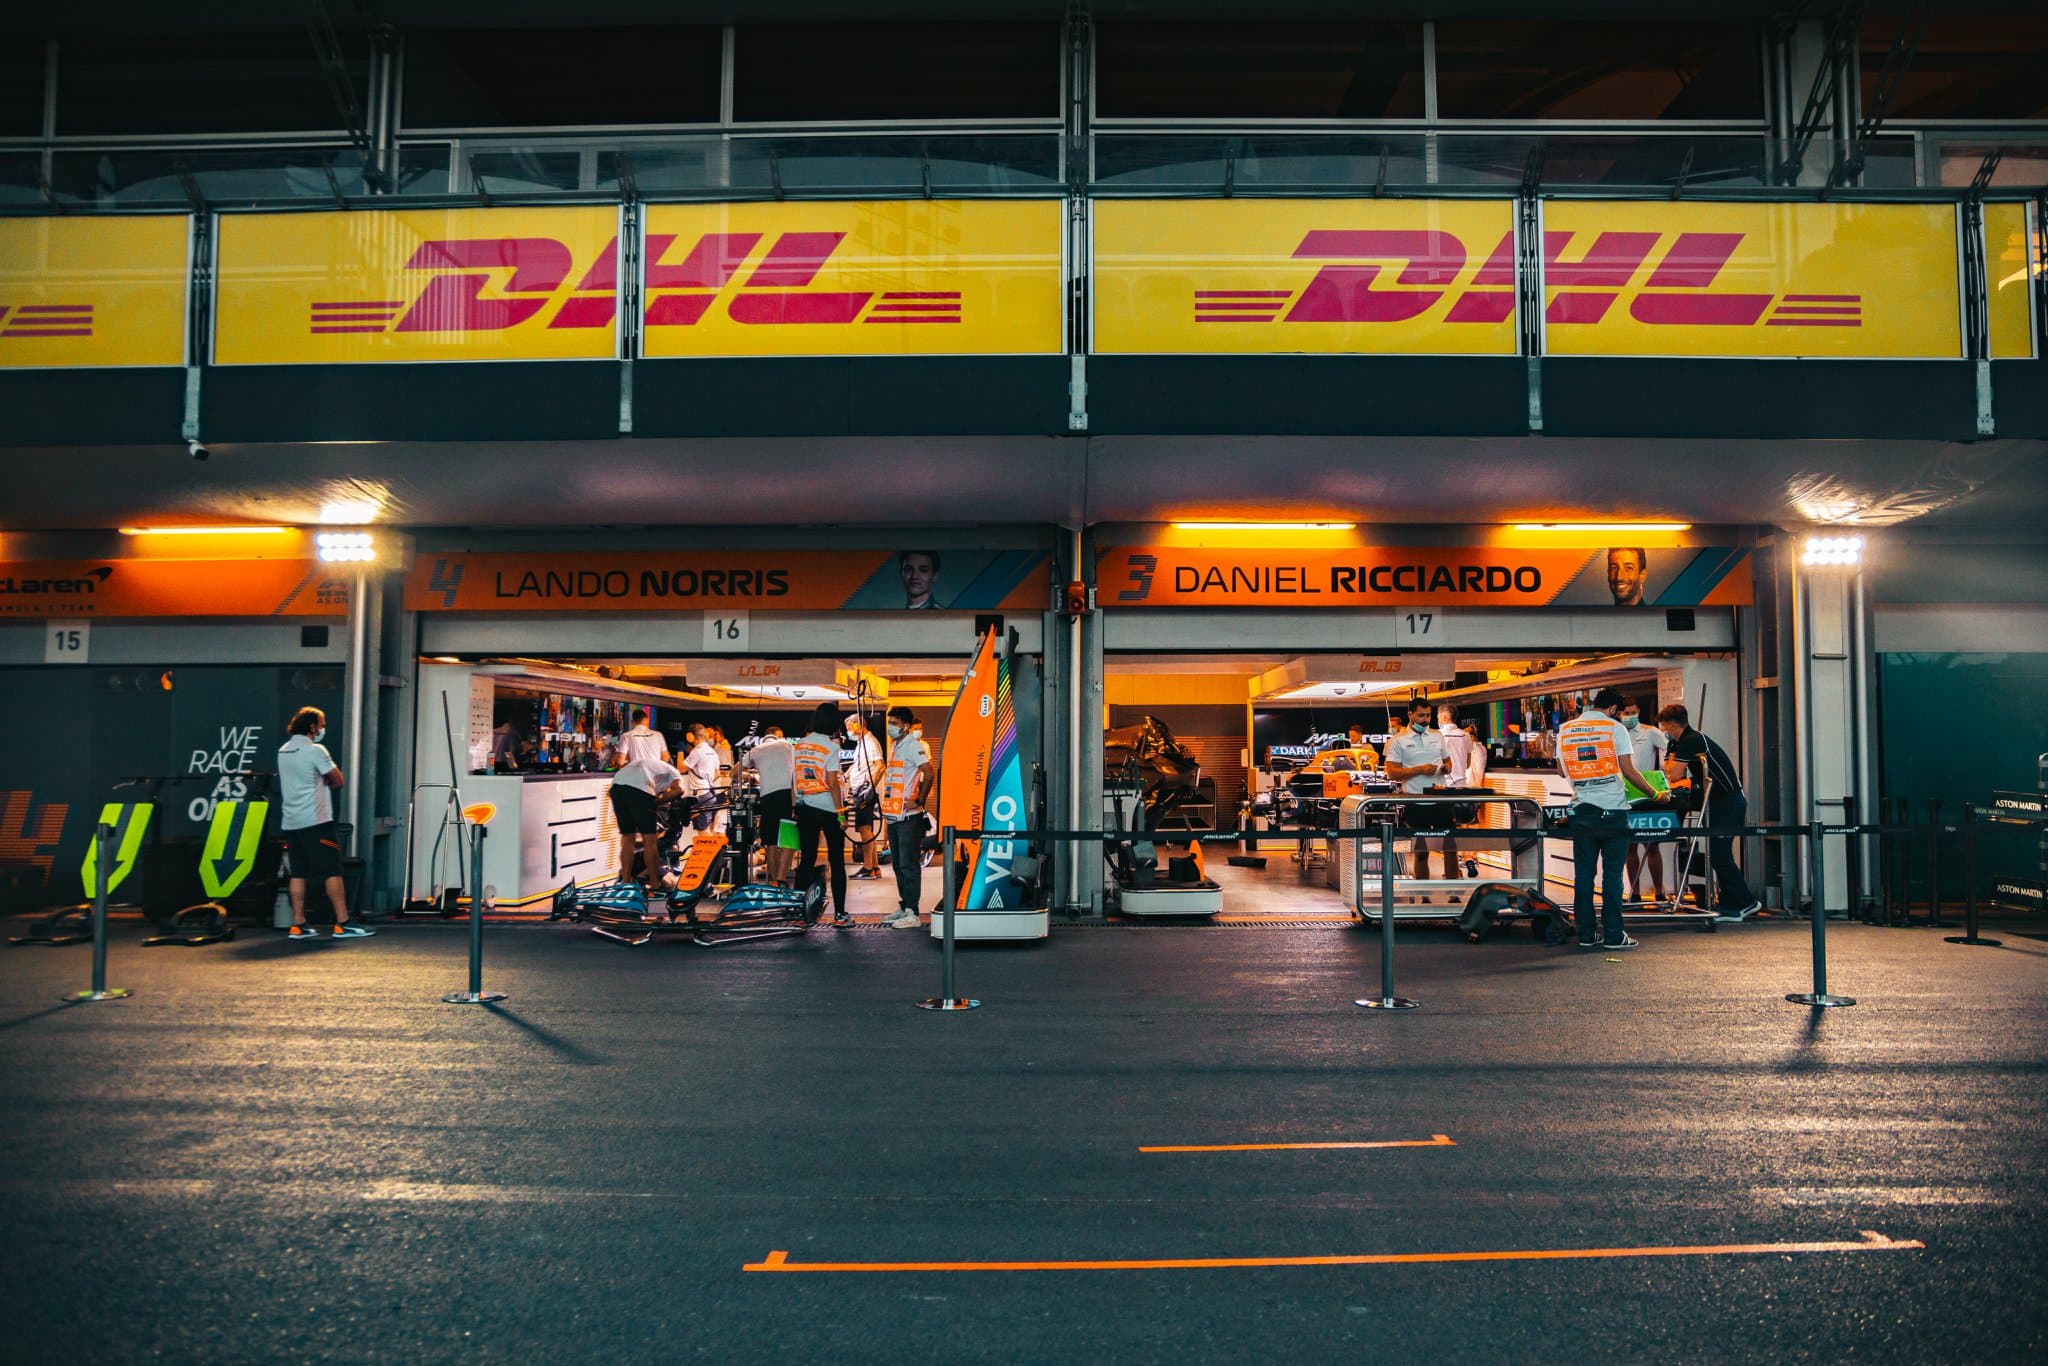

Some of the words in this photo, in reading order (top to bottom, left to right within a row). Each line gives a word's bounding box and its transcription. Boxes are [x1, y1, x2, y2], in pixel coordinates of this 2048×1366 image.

[396, 232, 873, 330] DHL
[1285, 230, 1774, 324] DHL
[0, 578, 94, 593] cLaren
[428, 559, 464, 608] 4
[495, 570, 629, 598] LANDO
[640, 569, 789, 597] NORRIS
[1117, 554, 1158, 601] 3
[1175, 565, 1321, 594] DANIEL
[1330, 565, 1542, 594] RICCIARDO
[713, 618, 740, 640] 16
[1405, 613, 1433, 635] 17
[55, 631, 80, 651] 15
[220, 726, 263, 750] WE
[188, 750, 257, 774] RACE
[211, 775, 248, 798] AS
[1545, 808, 1568, 819] VEL
[1995, 799, 2019, 810] ASTON
[2019, 801, 2042, 812] MARTIN
[1628, 816, 1673, 829] VELO
[1996, 884, 2020, 894] ASTON
[2020, 887, 2043, 899] MARTIN
